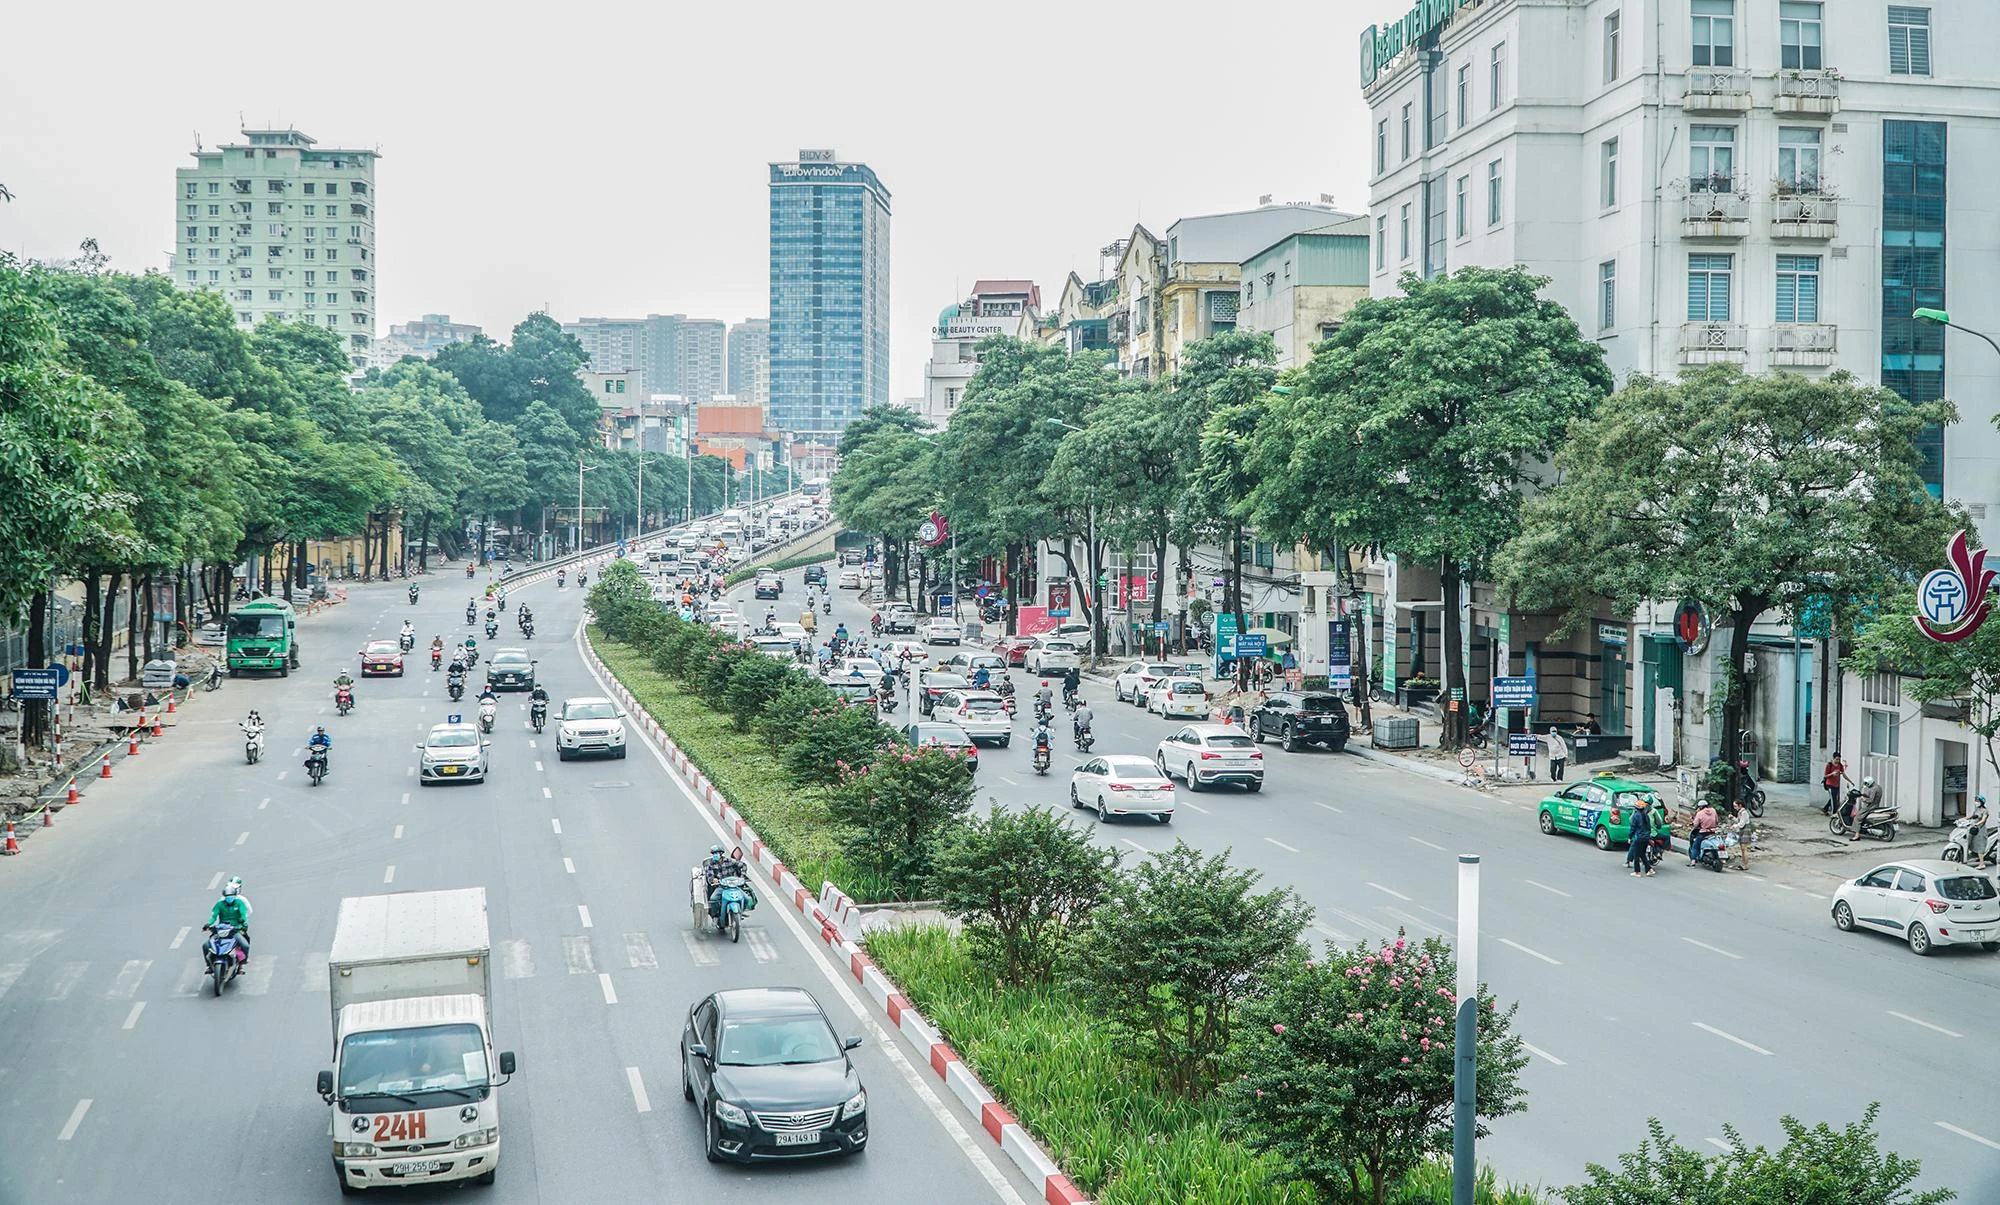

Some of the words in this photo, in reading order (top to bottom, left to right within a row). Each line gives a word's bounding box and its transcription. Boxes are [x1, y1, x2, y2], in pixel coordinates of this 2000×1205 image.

[800, 151, 821, 160] BIDV
[950, 326, 975, 334] BEAUTY
[976, 326, 1002, 334] CENTER
[373, 1112, 426, 1142] 24H
